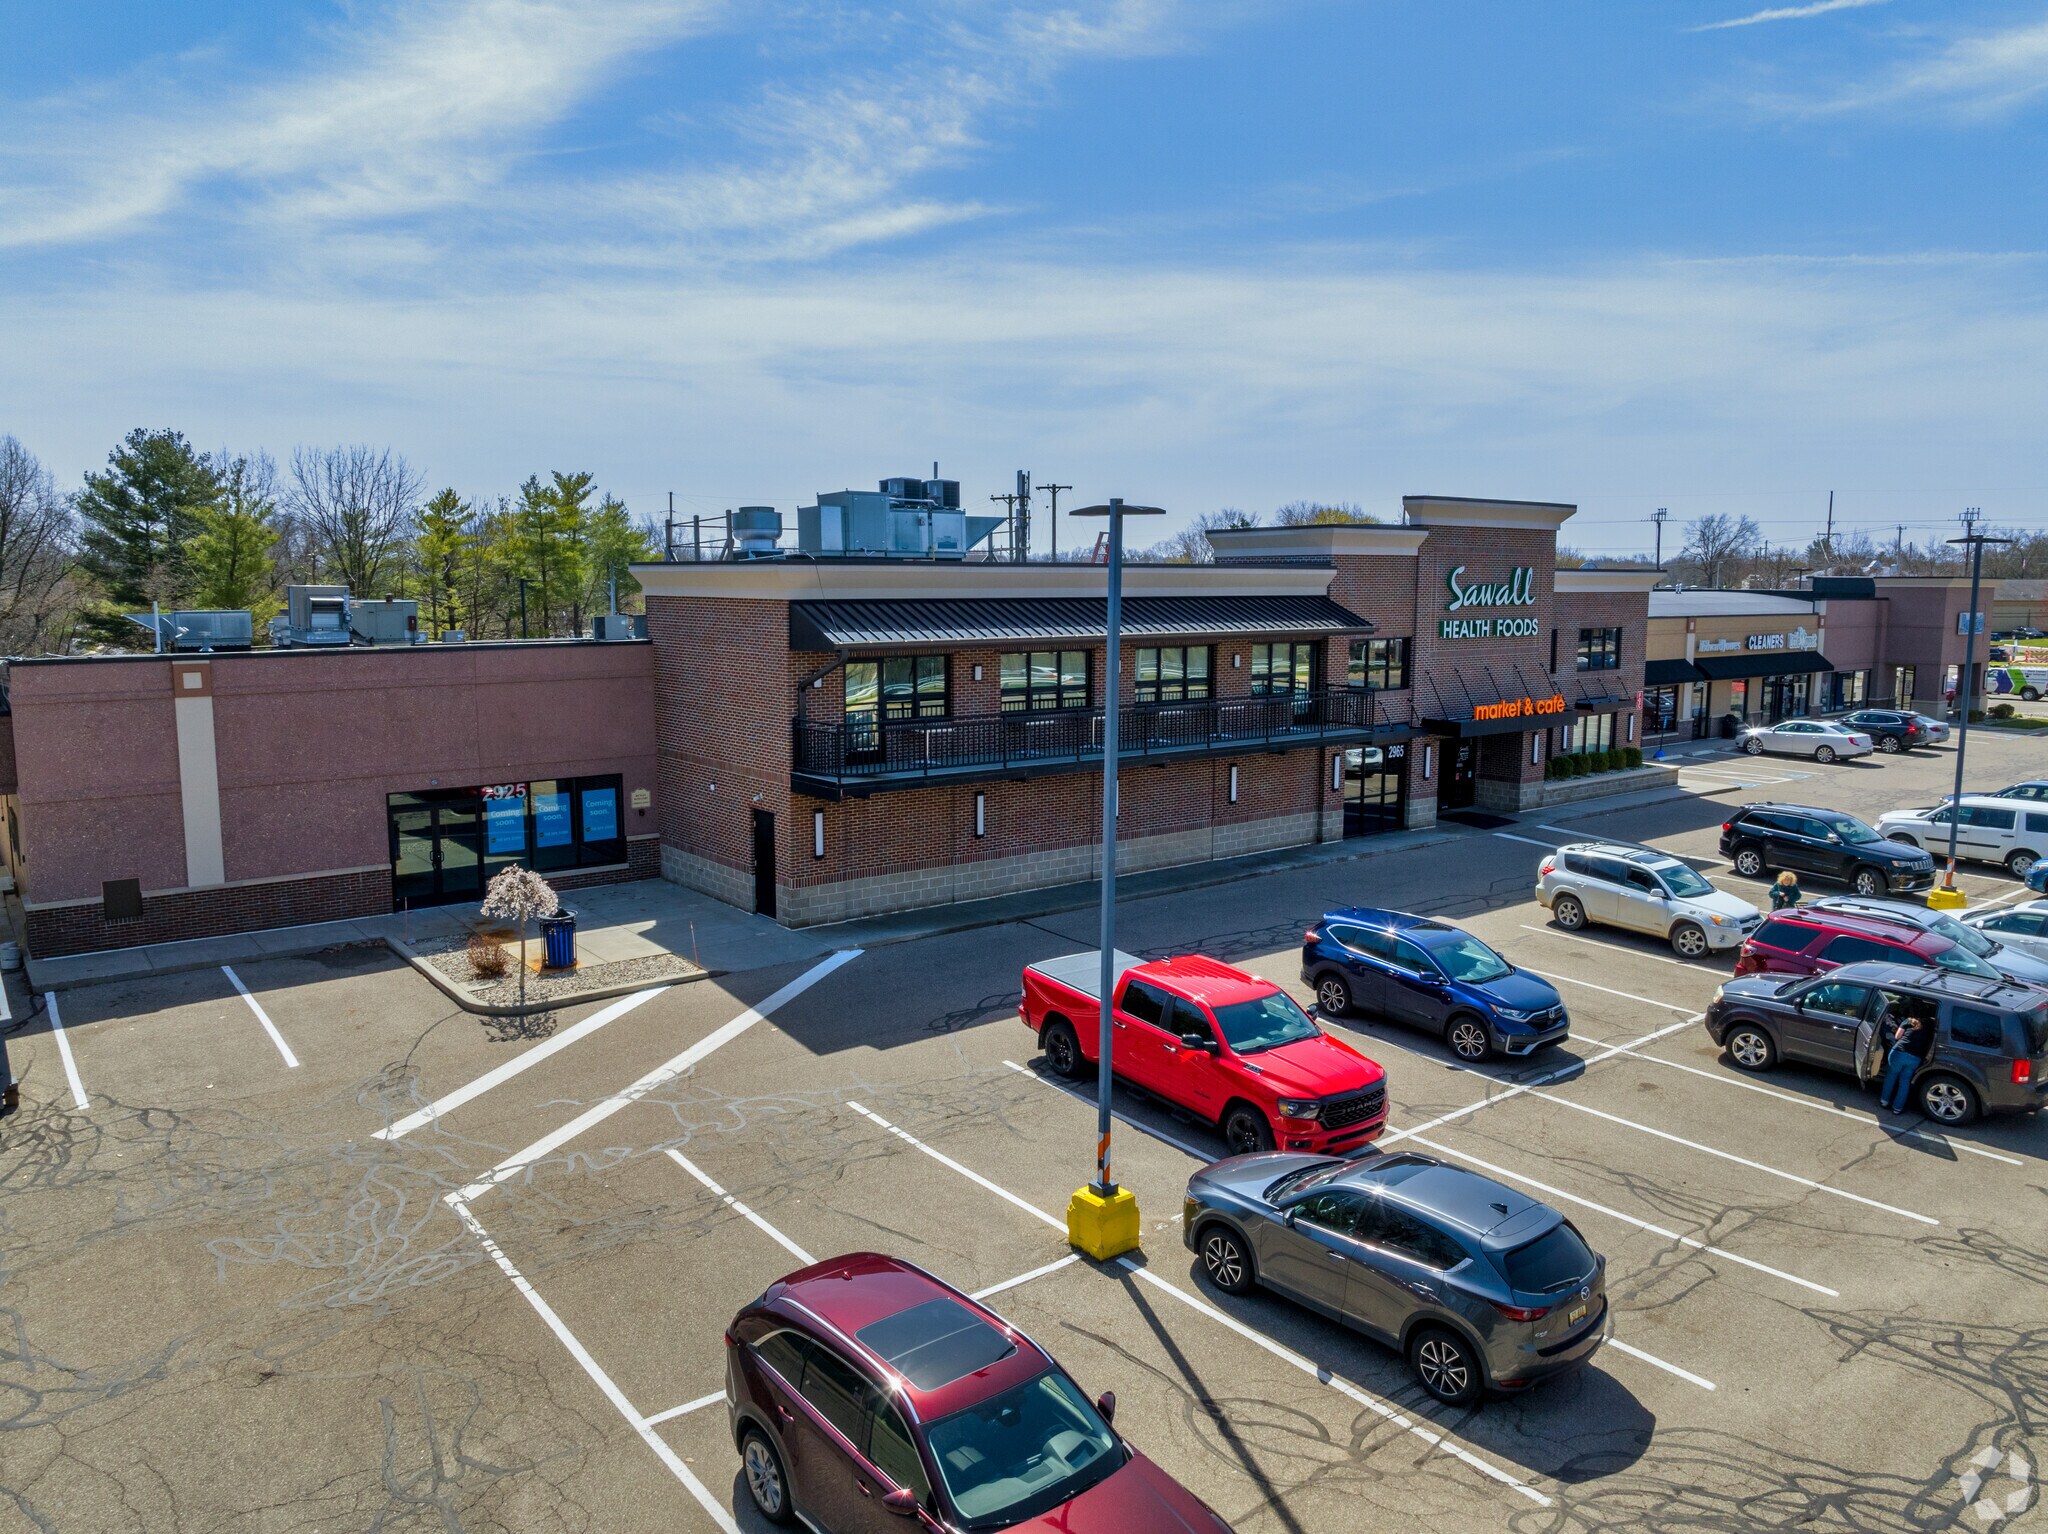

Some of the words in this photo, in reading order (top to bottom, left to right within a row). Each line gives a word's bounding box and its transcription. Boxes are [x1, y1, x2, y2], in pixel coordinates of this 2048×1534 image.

[1446, 566, 1536, 611] Sawall
[1442, 619, 1490, 639] HEALTH
[1496, 618, 1539, 637] FOODS
[1748, 634, 1784, 650] CLEANERS
[1474, 698, 1521, 720] market
[1523, 697, 1535, 716] &
[1536, 693, 1565, 715] café
[1388, 745, 1404, 758] 2965
[482, 783, 527, 801] 2925
[490, 809, 520, 817] Coming
[538, 803, 567, 812] Coming
